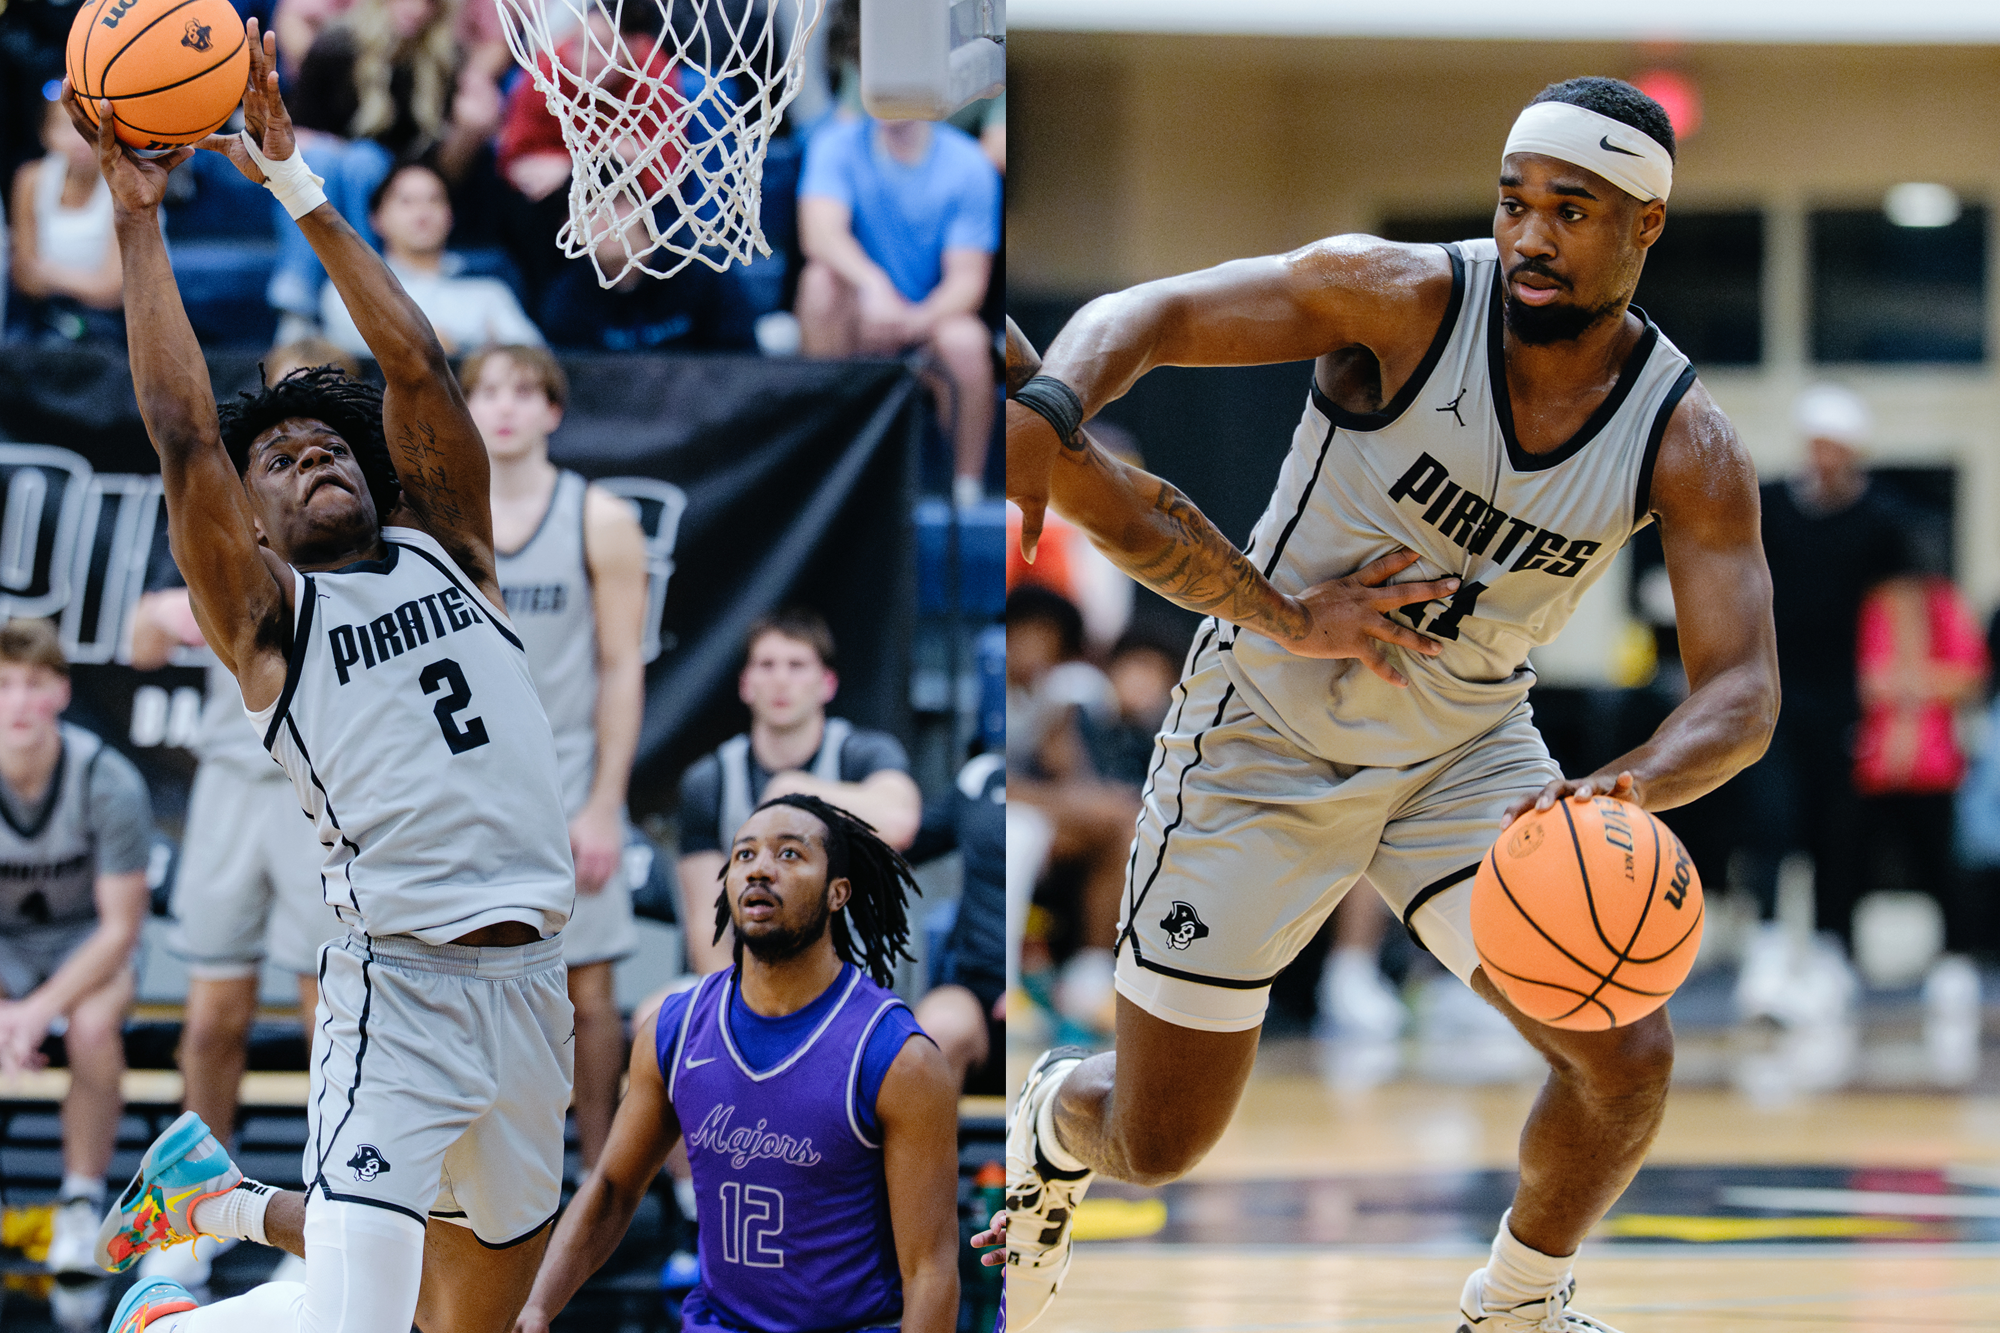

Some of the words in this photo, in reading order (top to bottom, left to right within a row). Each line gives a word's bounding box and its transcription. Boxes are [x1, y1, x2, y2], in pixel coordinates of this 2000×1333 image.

[1388, 452, 1602, 578] PIRATES
[419, 658, 490, 755] 2
[691, 1103, 821, 1170] Majors
[720, 1182, 784, 1268] 12
